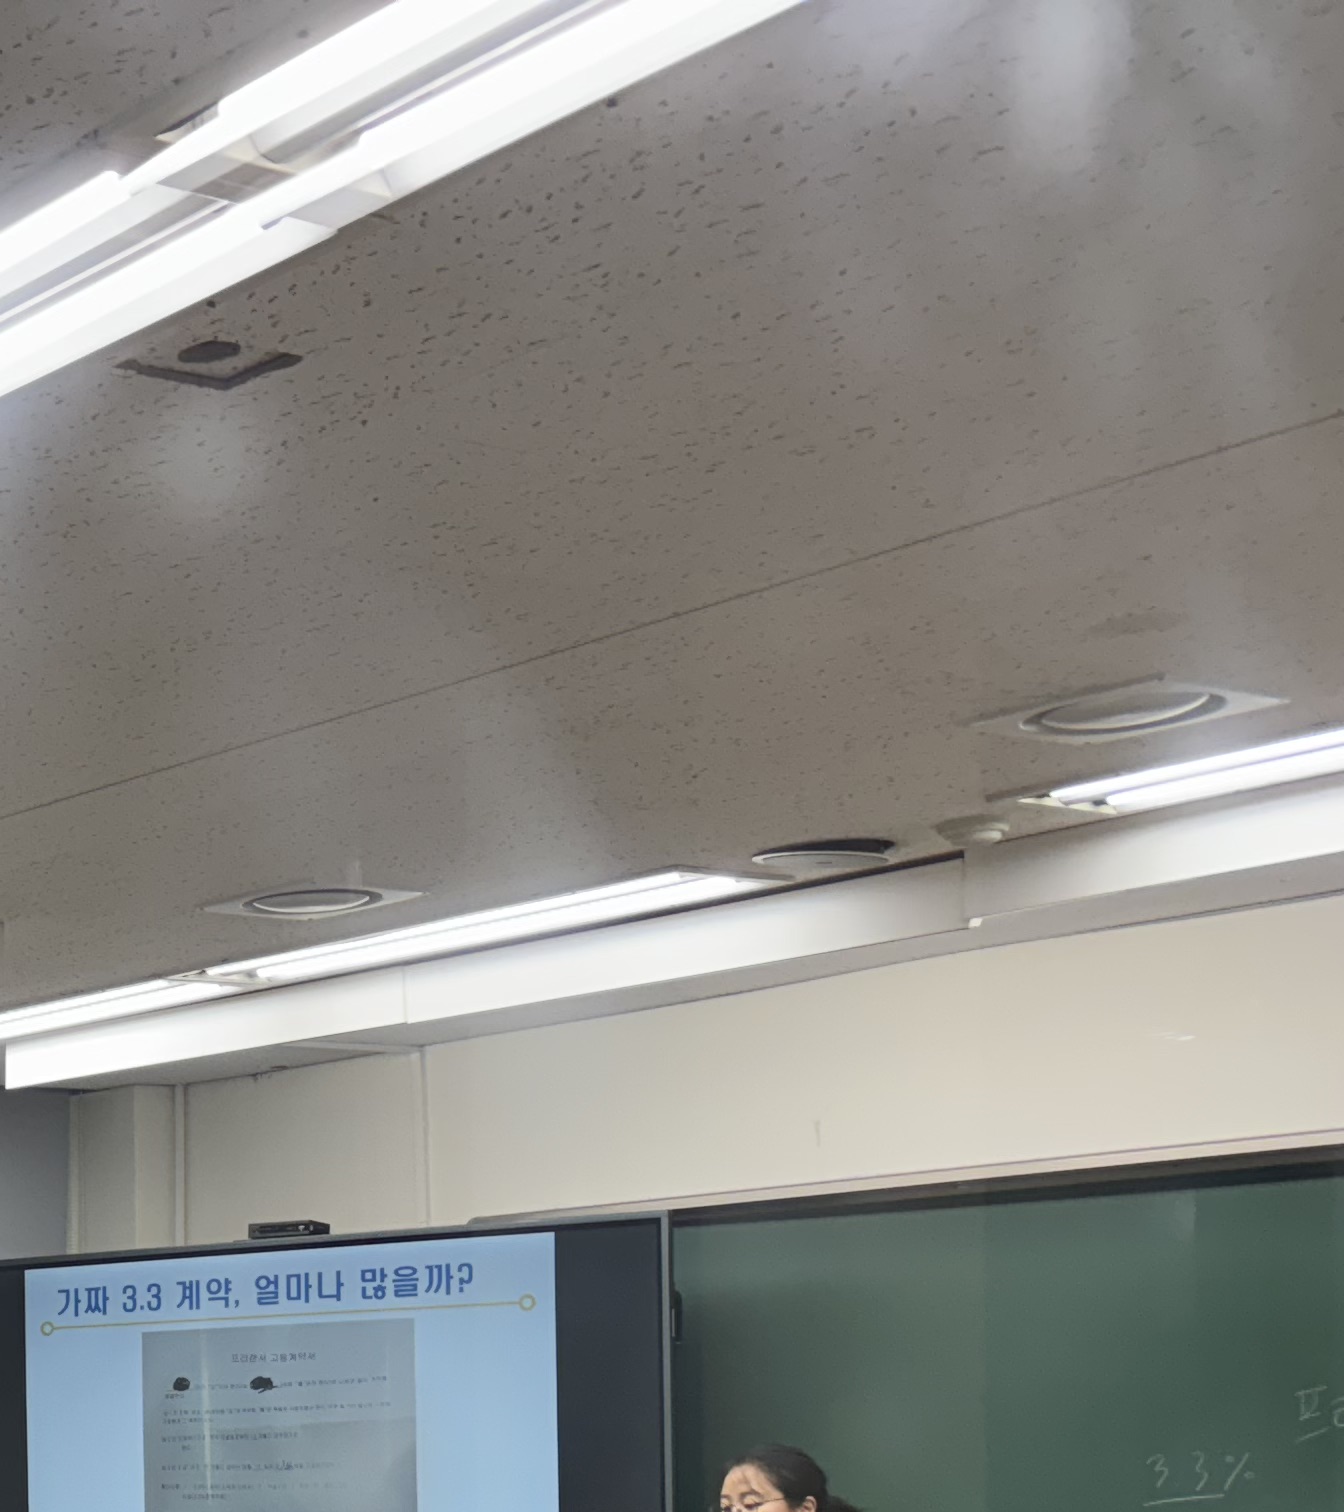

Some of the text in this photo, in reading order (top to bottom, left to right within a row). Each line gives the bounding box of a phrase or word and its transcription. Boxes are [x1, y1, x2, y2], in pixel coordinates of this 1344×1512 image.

[57, 1263, 474, 1318] 가짜 3.3 계약, 얼마나 많을까?
